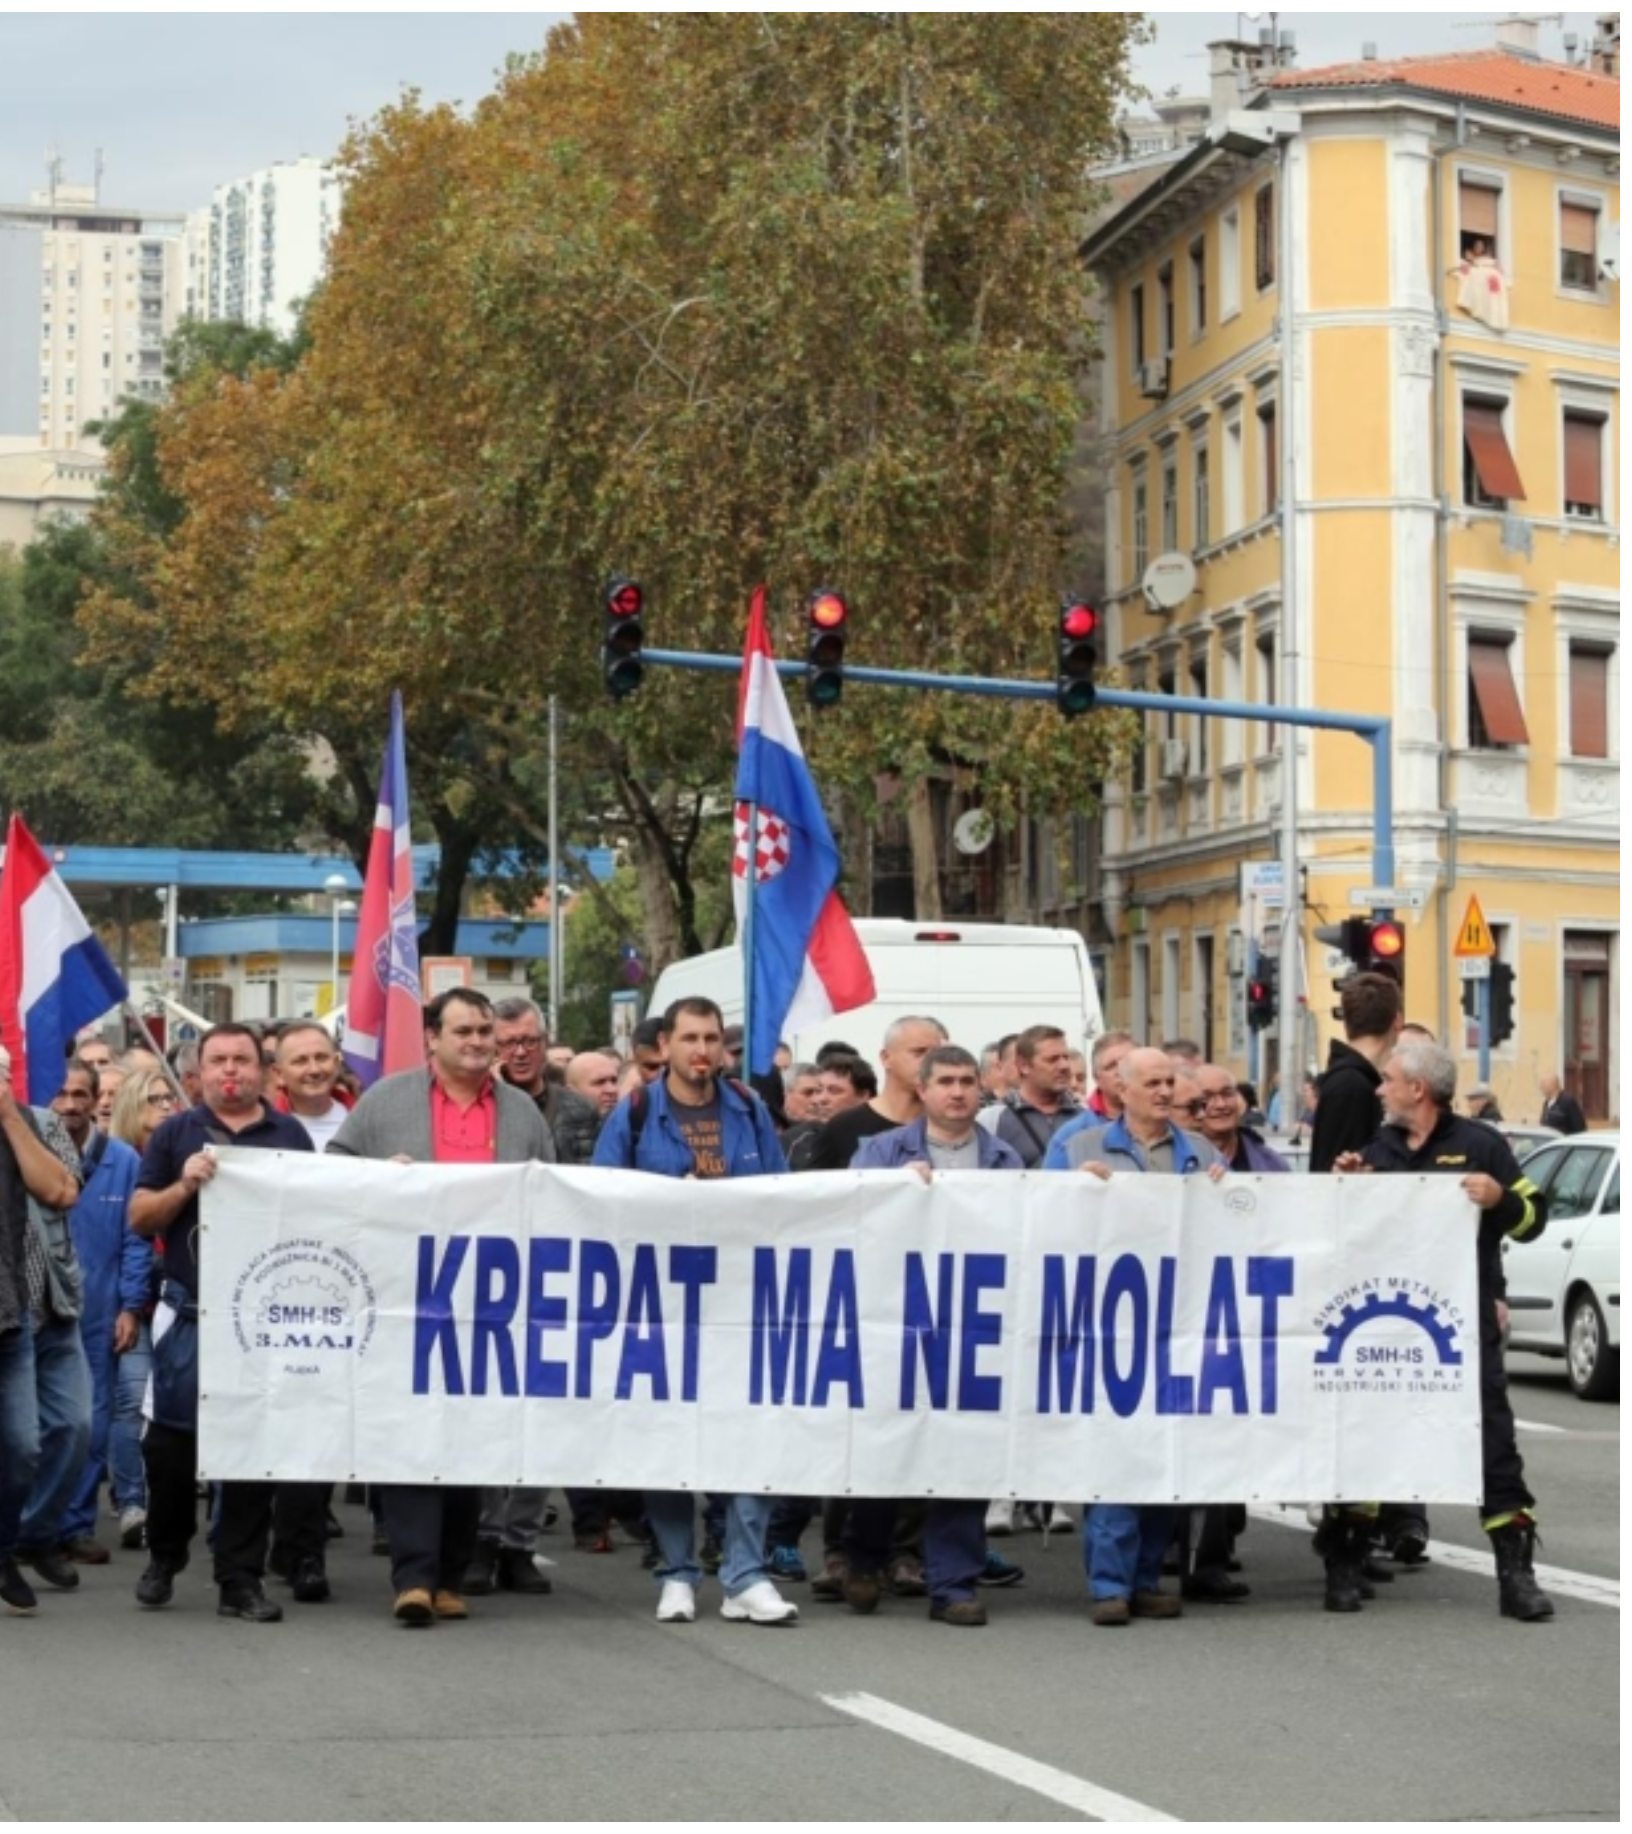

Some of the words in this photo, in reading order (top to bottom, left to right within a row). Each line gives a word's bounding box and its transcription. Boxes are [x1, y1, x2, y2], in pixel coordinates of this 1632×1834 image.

[1312, 1277, 1380, 1327] SINDIKAT
[1387, 1277, 1464, 1329] METALACA
[268, 1304, 343, 1325] SMH-IS
[412, 1235, 717, 1401] KREPAT
[749, 1247, 865, 1408] MA
[901, 1252, 1007, 1410] NE
[1037, 1253, 1294, 1417] MOLAT
[1356, 1346, 1424, 1364] SMH-IS
[1314, 1367, 1462, 1379] HRVATSKE
[1314, 1380, 1400, 1392] INDUSTRIJSKI
